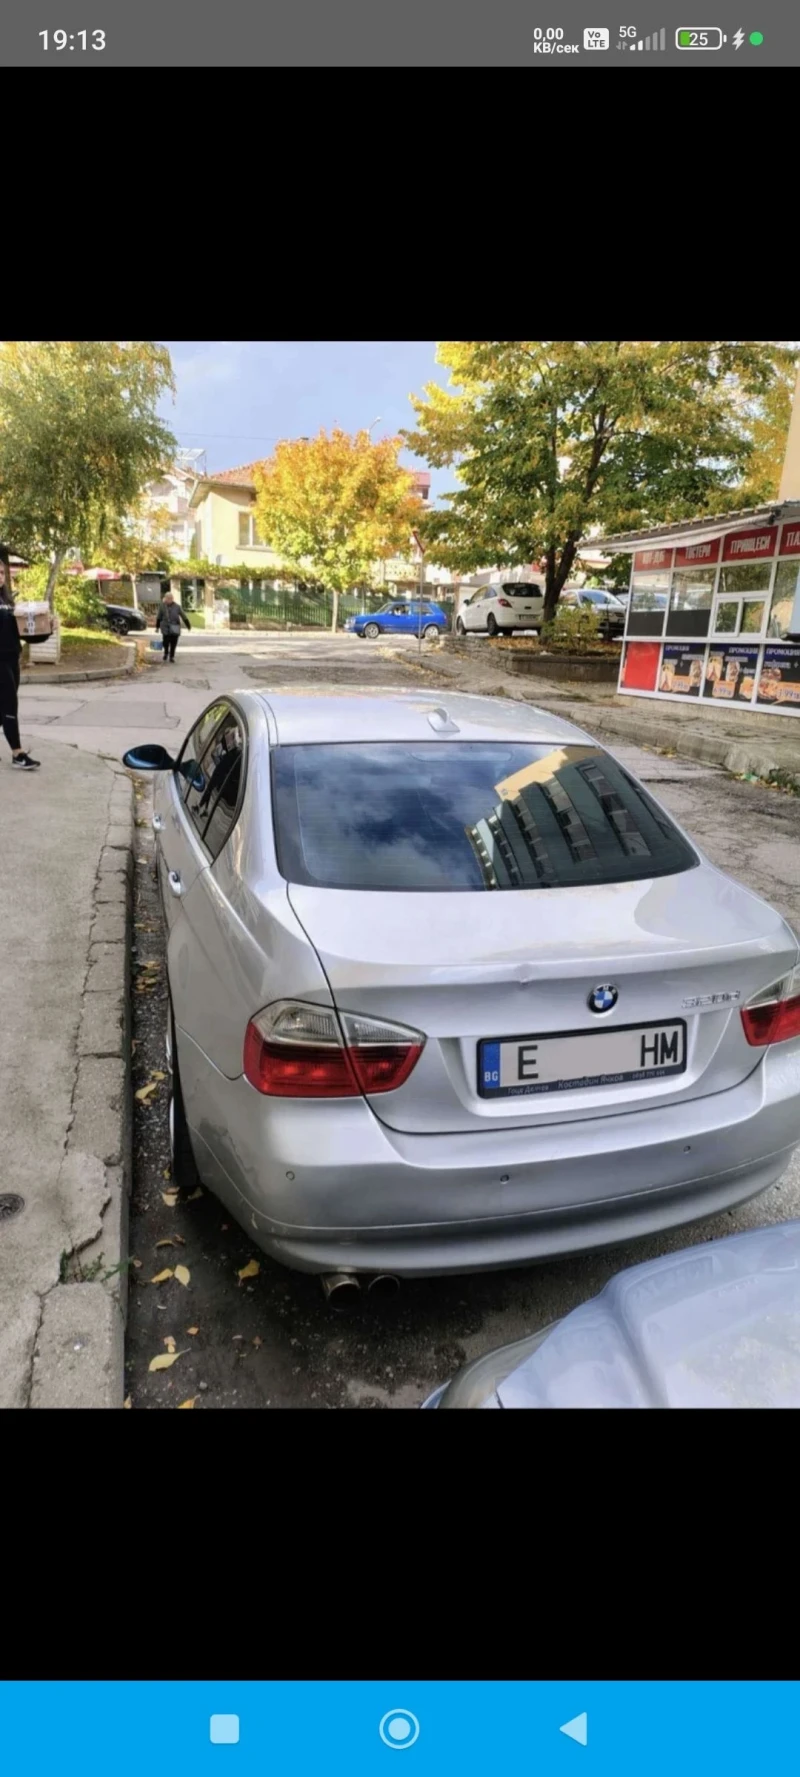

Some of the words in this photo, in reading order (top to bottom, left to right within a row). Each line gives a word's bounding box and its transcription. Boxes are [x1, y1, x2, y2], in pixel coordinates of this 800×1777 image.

[518, 1045, 539, 1080] E
[640, 1031, 679, 1067] HM
[484, 1071, 499, 1082] BG
